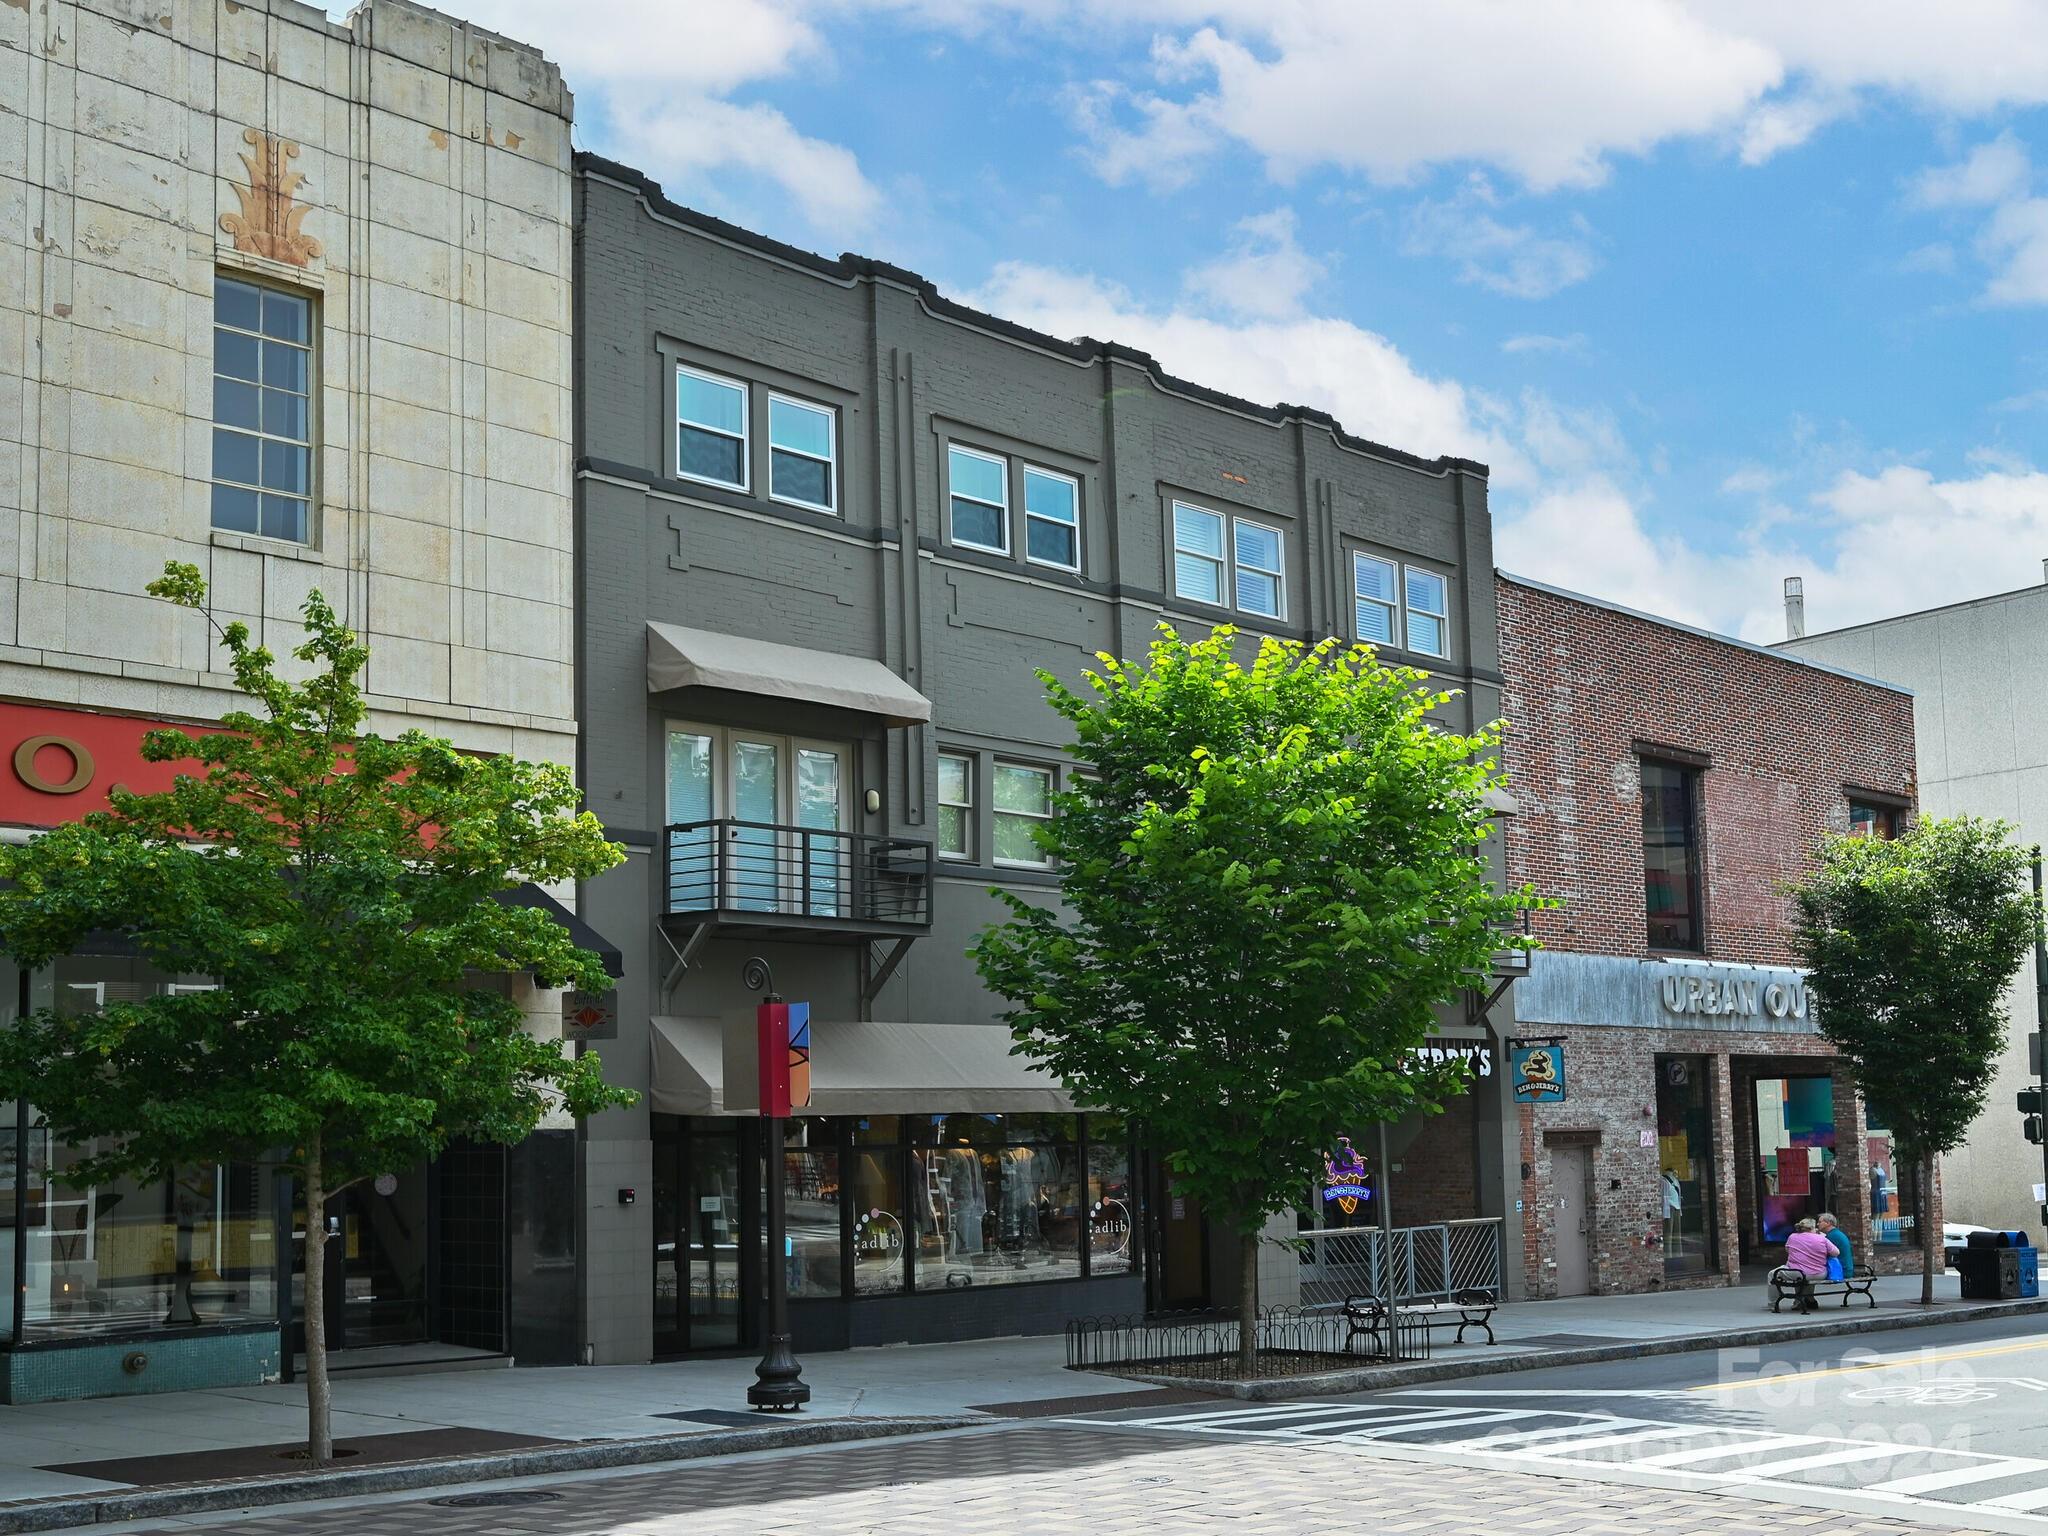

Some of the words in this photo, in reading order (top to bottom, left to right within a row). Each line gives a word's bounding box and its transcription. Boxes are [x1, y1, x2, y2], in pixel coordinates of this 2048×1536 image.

[1661, 975, 1759, 1017] URBAN
[1095, 1220, 1127, 1234] adlib
[861, 1233, 899, 1250] adlib
